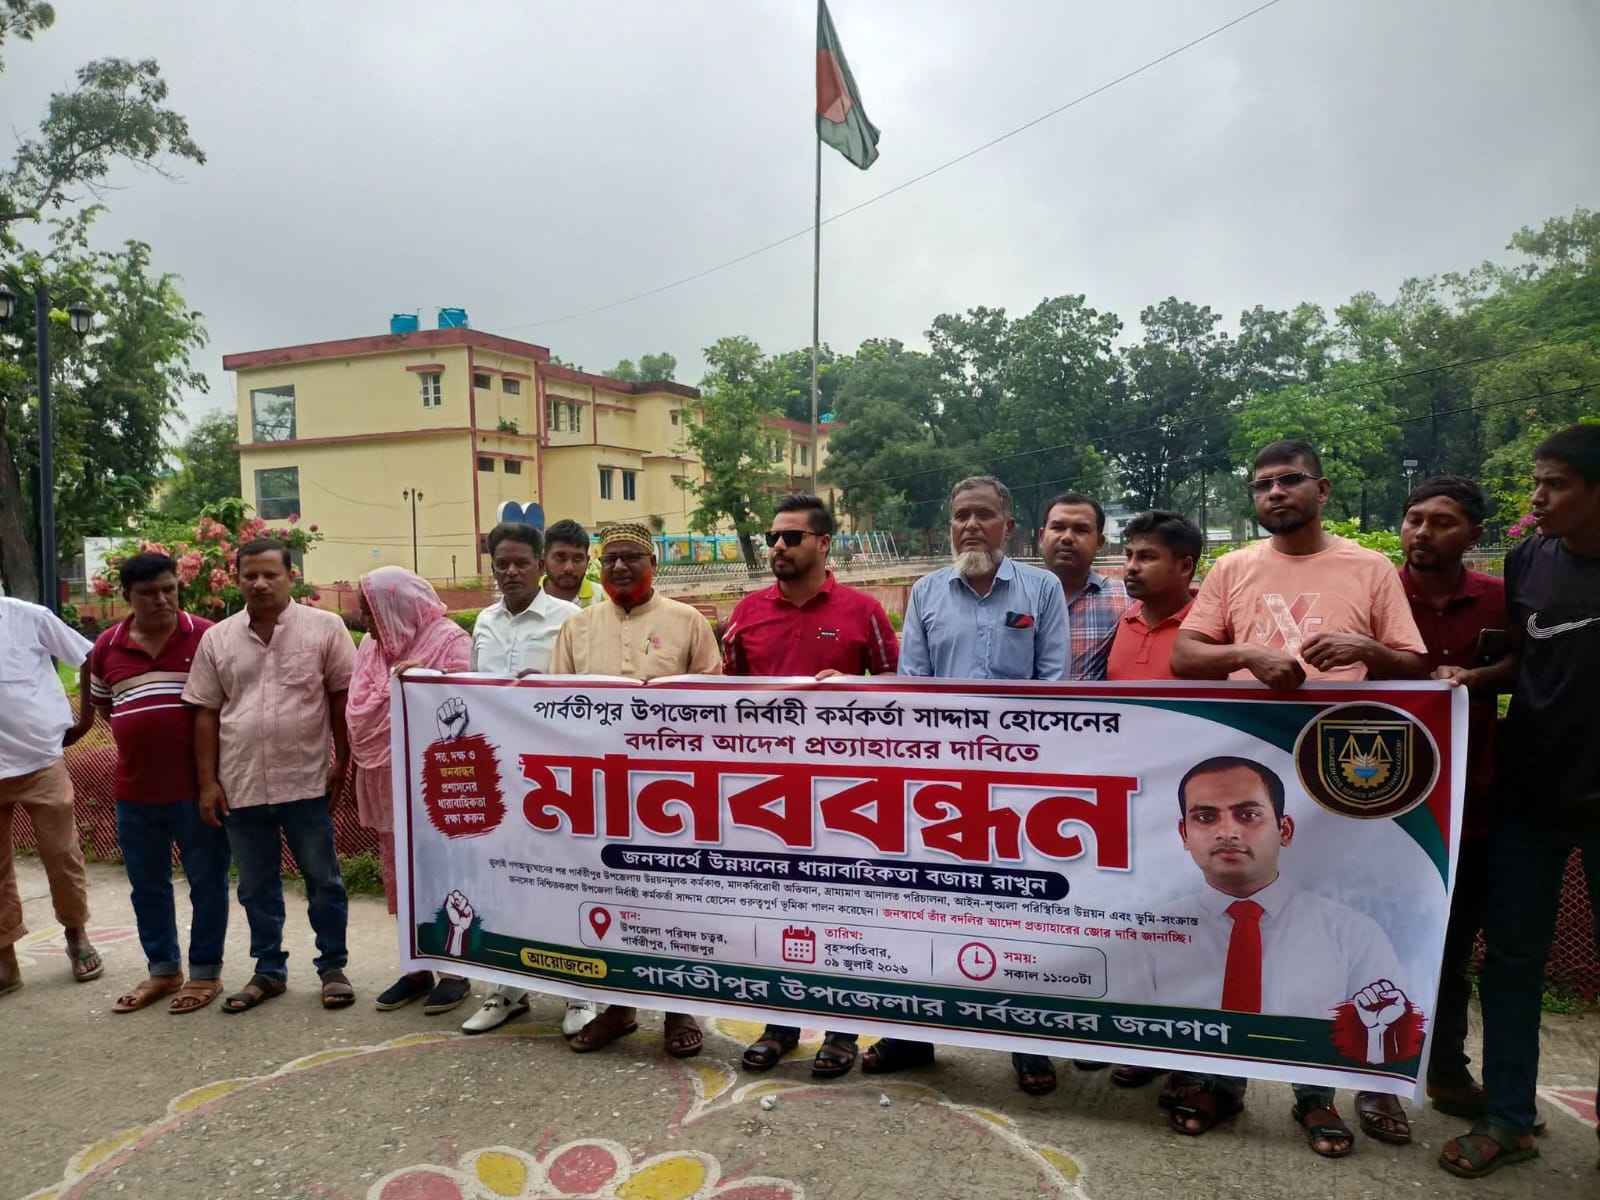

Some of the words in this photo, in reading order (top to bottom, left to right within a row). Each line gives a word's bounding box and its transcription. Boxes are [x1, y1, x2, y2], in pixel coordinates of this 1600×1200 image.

[533, 695, 624, 726] পার্বতীপুর
[631, 697, 727, 724] উপজেলা
[735, 698, 808, 725] নির্বাহী
[814, 699, 904, 728] কর্মকর্তা
[912, 707, 990, 730] সাদ্দাম
[999, 709, 1121, 733] হোসেনের
[469, 750, 476, 760] ও
[624, 727, 704, 751] বদলির
[712, 734, 795, 754] আদেশ
[805, 736, 941, 759] প্রত্যাহারের
[949, 734, 1040, 762] দাবিতে
[438, 795, 487, 809] ধারাবাহিকতা
[519, 753, 1139, 870] মানববন্ধন
[622, 850, 701, 869] জনস্বার্থে
[708, 852, 790, 875] উন্নয়নের
[798, 859, 918, 884] ধারাবাহিকতা
[925, 867, 984, 890] বজায়
[991, 874, 1047, 896] রাখুন
[555, 868, 566, 876] পর
[569, 866, 600, 880] পার্বতীপুর
[603, 870, 641, 883] উপজেলায়
[728, 879, 780, 892] মাদকবিরোধী
[784, 883, 821, 896] অভিযান,
[864, 890, 900, 901] আদালত
[903, 892, 950, 906] পরিচালনা,
[1022, 901, 1070, 917] পরিস্থিতির
[1074, 906, 1105, 920] উন্নয়ন
[1109, 912, 1131, 922] এবং
[509, 875, 535, 887] জনসেবা
[581, 882, 613, 896] উপজেলা
[616, 885, 639, 899] নির্বাহী
[642, 888, 673, 901] কর্মকর্তা
[675, 893, 703, 904] সাদ্দাম
[705, 895, 736, 905] হোসেন
[811, 903, 835, 913] পালন
[883, 908, 924, 921] জনস্বার্থে
[928, 908, 946, 923] তাঁর
[951, 911, 983, 926] বদলির
[987, 917, 1021, 930] আদেশ
[1025, 921, 1080, 936] প্রত্যাহারের
[1084, 925, 1111, 939] জোর
[1115, 926, 1137, 941] দাবি
[619, 910, 641, 921] স্থান:
[620, 921, 661, 936] উপজেলা
[665, 927, 697, 940] পরিষদ
[700, 932, 727, 945] চত্বর,
[824, 926, 863, 941] তারিখ:
[621, 935, 667, 951] পার্বতীপুর,
[670, 941, 714, 956] দিনাজপুর
[824, 941, 892, 959] বৃহস্পতিবার,
[527, 951, 599, 975] আয়োজনে:
[824, 958, 840, 968] ০৯
[842, 957, 874, 972] জুলাই
[877, 962, 909, 975] ২০২৬
[1003, 951, 1037, 965] সময়:
[1003, 969, 1039, 982] সকাল
[1043, 970, 1092, 985] ১১:০০টা
[632, 964, 770, 1000] পার্বতীপুর
[778, 975, 945, 1018] উপজেলার
[955, 998, 1102, 1032] সর্বস্তরের
[1111, 1014, 1231, 1045] জনগণ
